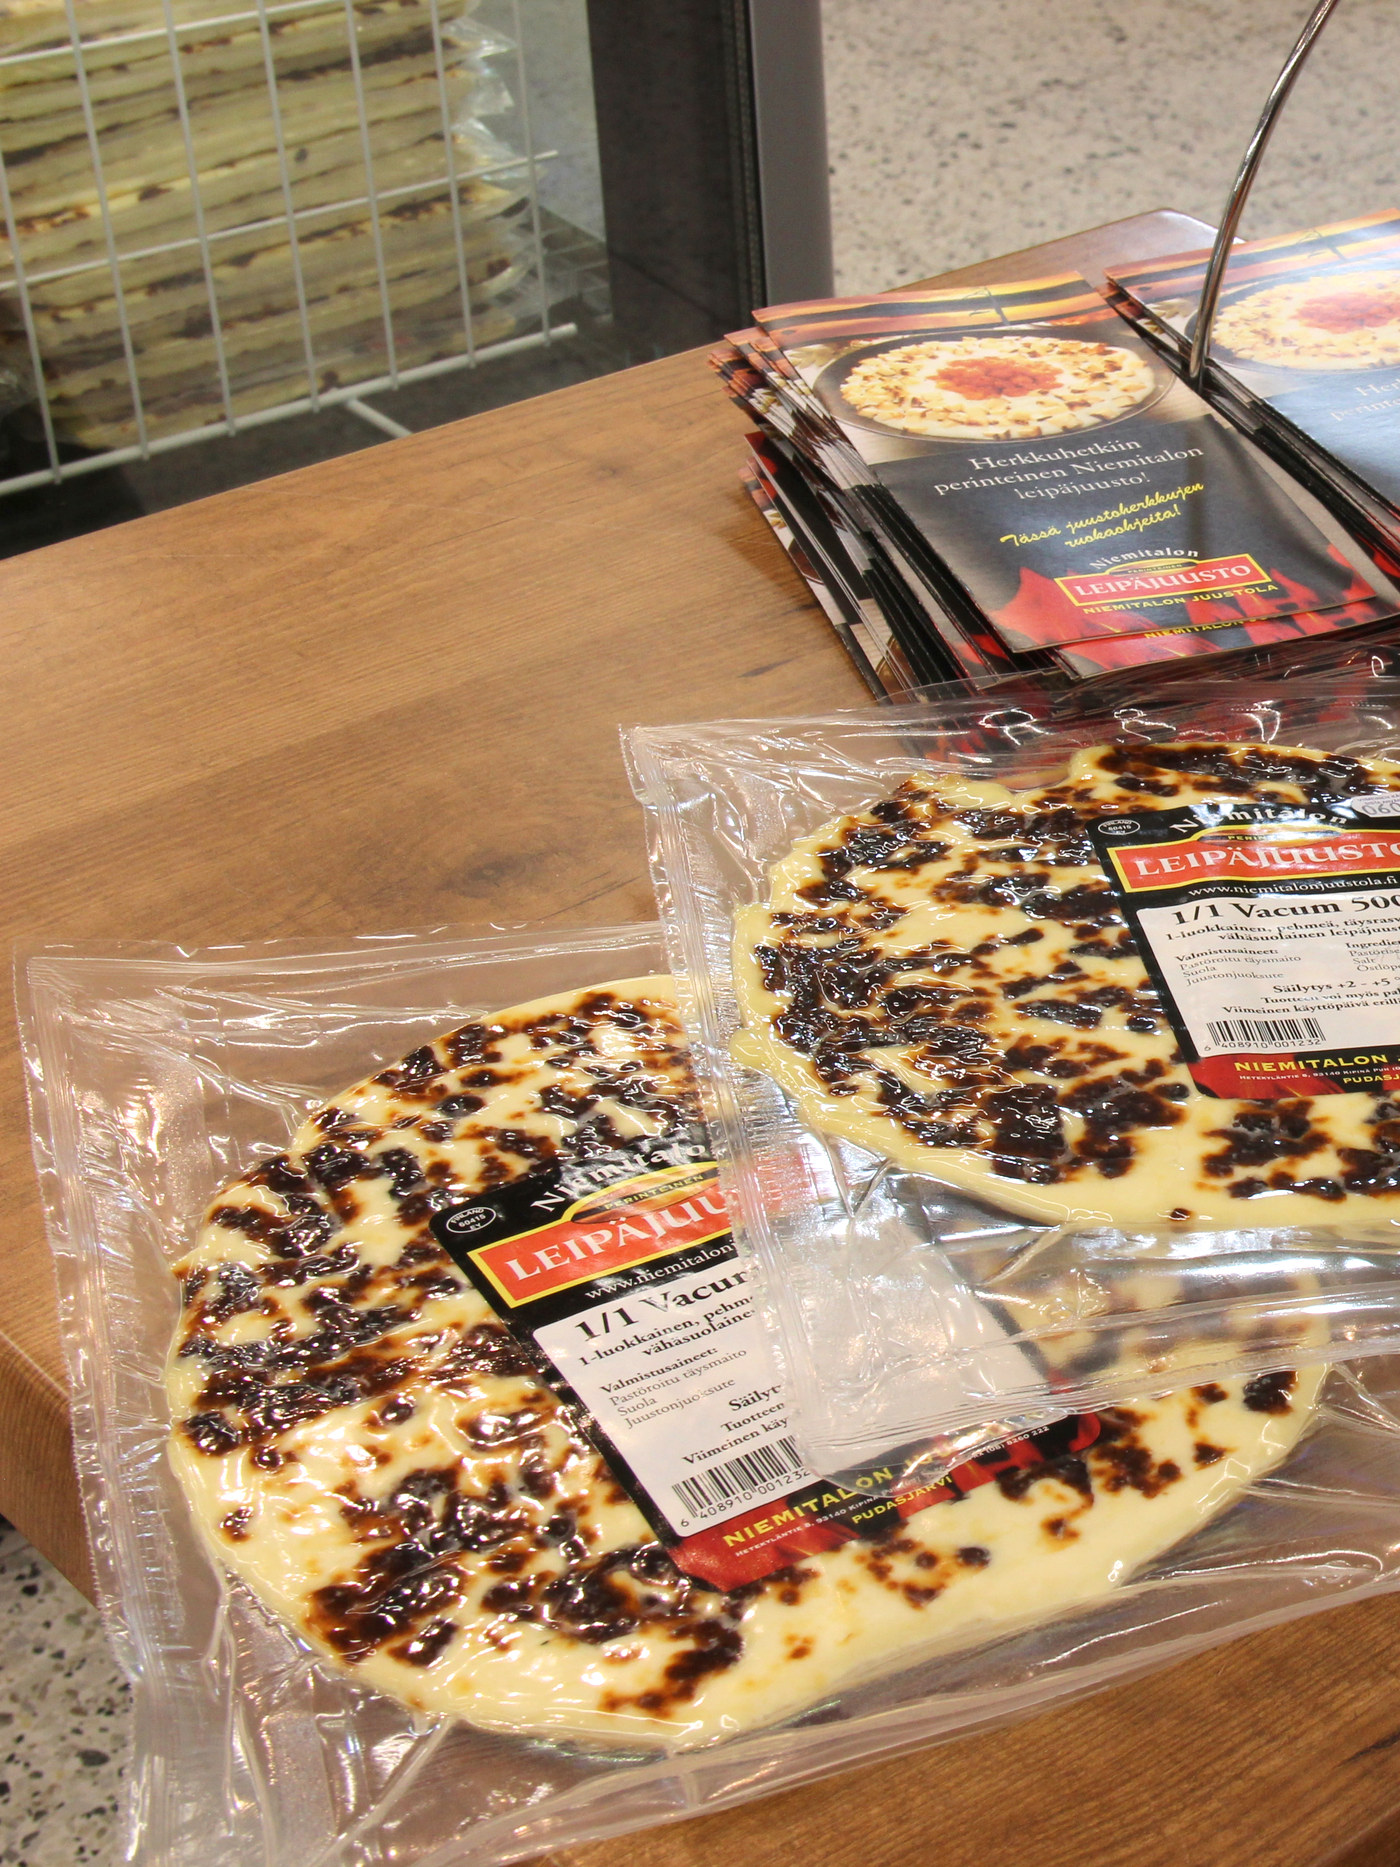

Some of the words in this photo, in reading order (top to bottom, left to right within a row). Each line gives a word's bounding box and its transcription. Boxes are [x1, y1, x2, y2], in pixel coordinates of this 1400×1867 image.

[968, 440, 1142, 470] Herkkuhetkiin
[934, 468, 1068, 496] perinteinen
[1069, 447, 1204, 475] Niemitalon
[1014, 471, 1150, 499] leipäjuusto!
[1000, 526, 1061, 547] Tässä
[1066, 482, 1204, 534] juustoherkkujen
[1064, 504, 1182, 548] ruokaohjeita!
[1089, 547, 1199, 570] Niemitalon
[1074, 564, 1252, 596] LEIPÄJUUSTO
[1083, 596, 1185, 614] NIEMITALON
[1191, 584, 1279, 602] JUUSTOLA
[1170, 807, 1347, 833] Niemitalon
[1188, 875, 1398, 896] www.niemitalonjuustola.fi
[1172, 904, 1224, 926] 1/1
[1229, 901, 1342, 918] Vacum
[1166, 924, 1272, 940] 1-luokkainen,
[1276, 921, 1339, 934] pehmeä,
[1219, 930, 1326, 942] vähäsuolainen
[1176, 948, 1279, 962] Valmistusaineet:
[1179, 956, 1241, 971] Pastöroitu
[1244, 955, 1301, 965] täysmaito
[1352, 957, 1376, 965] Salt
[1183, 965, 1217, 978] Suola
[1186, 971, 1285, 987] Juustonjuoksute
[1273, 983, 1332, 994] Säilytys
[1337, 980, 1357, 989] +2
[1372, 977, 1391, 987] +5
[1222, 1005, 1290, 1014] Viimeinen
[1294, 1000, 1369, 1012] käyttöpäivä
[1322, 993, 1341, 1001] voi
[1346, 990, 1380, 1000] myös
[1221, 1040, 1269, 1049] 408910
[1274, 1038, 1321, 1048] 001232
[1234, 1054, 1388, 1072] NIEMITALON
[530, 1144, 706, 1212] Niemitalo
[604, 1174, 704, 1211] PERINTEINEN
[459, 1214, 486, 1227] 60415
[504, 1191, 728, 1281] LEIPÄJUU
[575, 1307, 639, 1342] 1/1
[642, 1309, 755, 1357] vähäsuolaine
[579, 1318, 700, 1367] 1-luokkainen,
[600, 1347, 718, 1394] Valmistusaineet:
[609, 1376, 681, 1407] Pastöroitu
[682, 1348, 747, 1378] täysmaito
[616, 1396, 658, 1417] Suola
[728, 1384, 782, 1411] Säilyt
[720, 1402, 785, 1433] Tuotteen
[681, 1430, 760, 1466] Viimeinen
[680, 1518, 690, 1528] 6
[700, 1490, 753, 1520] 408910
[757, 1468, 811, 1495] 001232
[722, 1467, 894, 1547] NIEMITALON
[851, 1475, 953, 1524] PUDASJÄRVI
